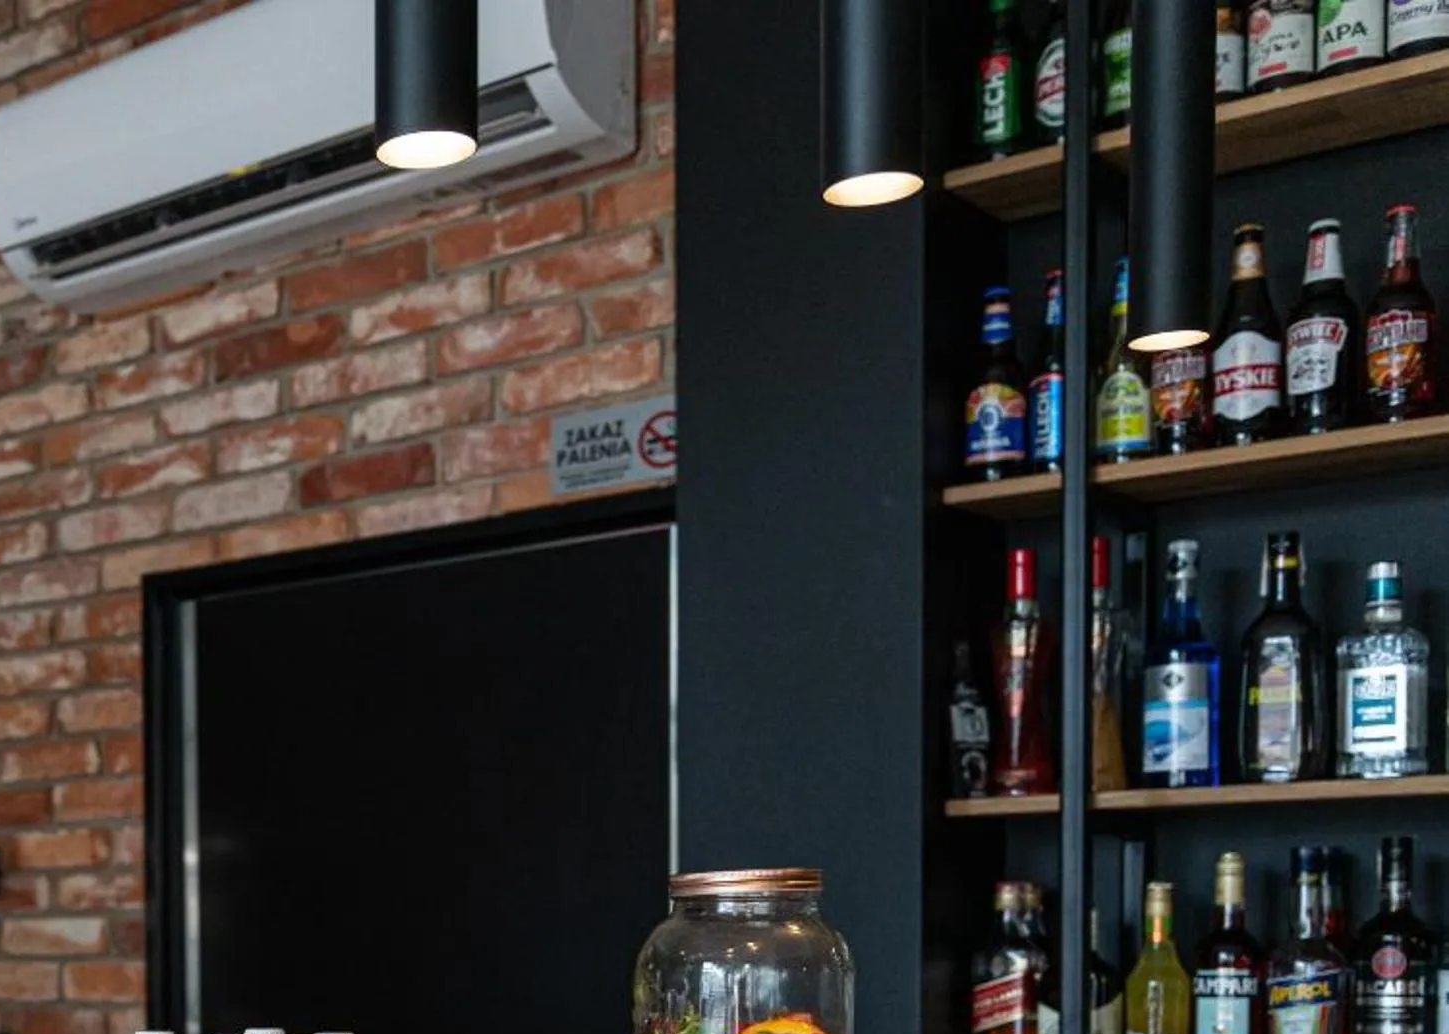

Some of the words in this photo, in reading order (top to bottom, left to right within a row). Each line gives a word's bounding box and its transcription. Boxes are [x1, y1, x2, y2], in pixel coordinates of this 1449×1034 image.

[1321, 20, 1368, 46] APA
[983, 72, 1005, 141] LECH
[564, 420, 625, 449] ZAKAZ
[556, 438, 633, 469] PALENIA
[1193, 976, 1259, 996] CAMPARI
